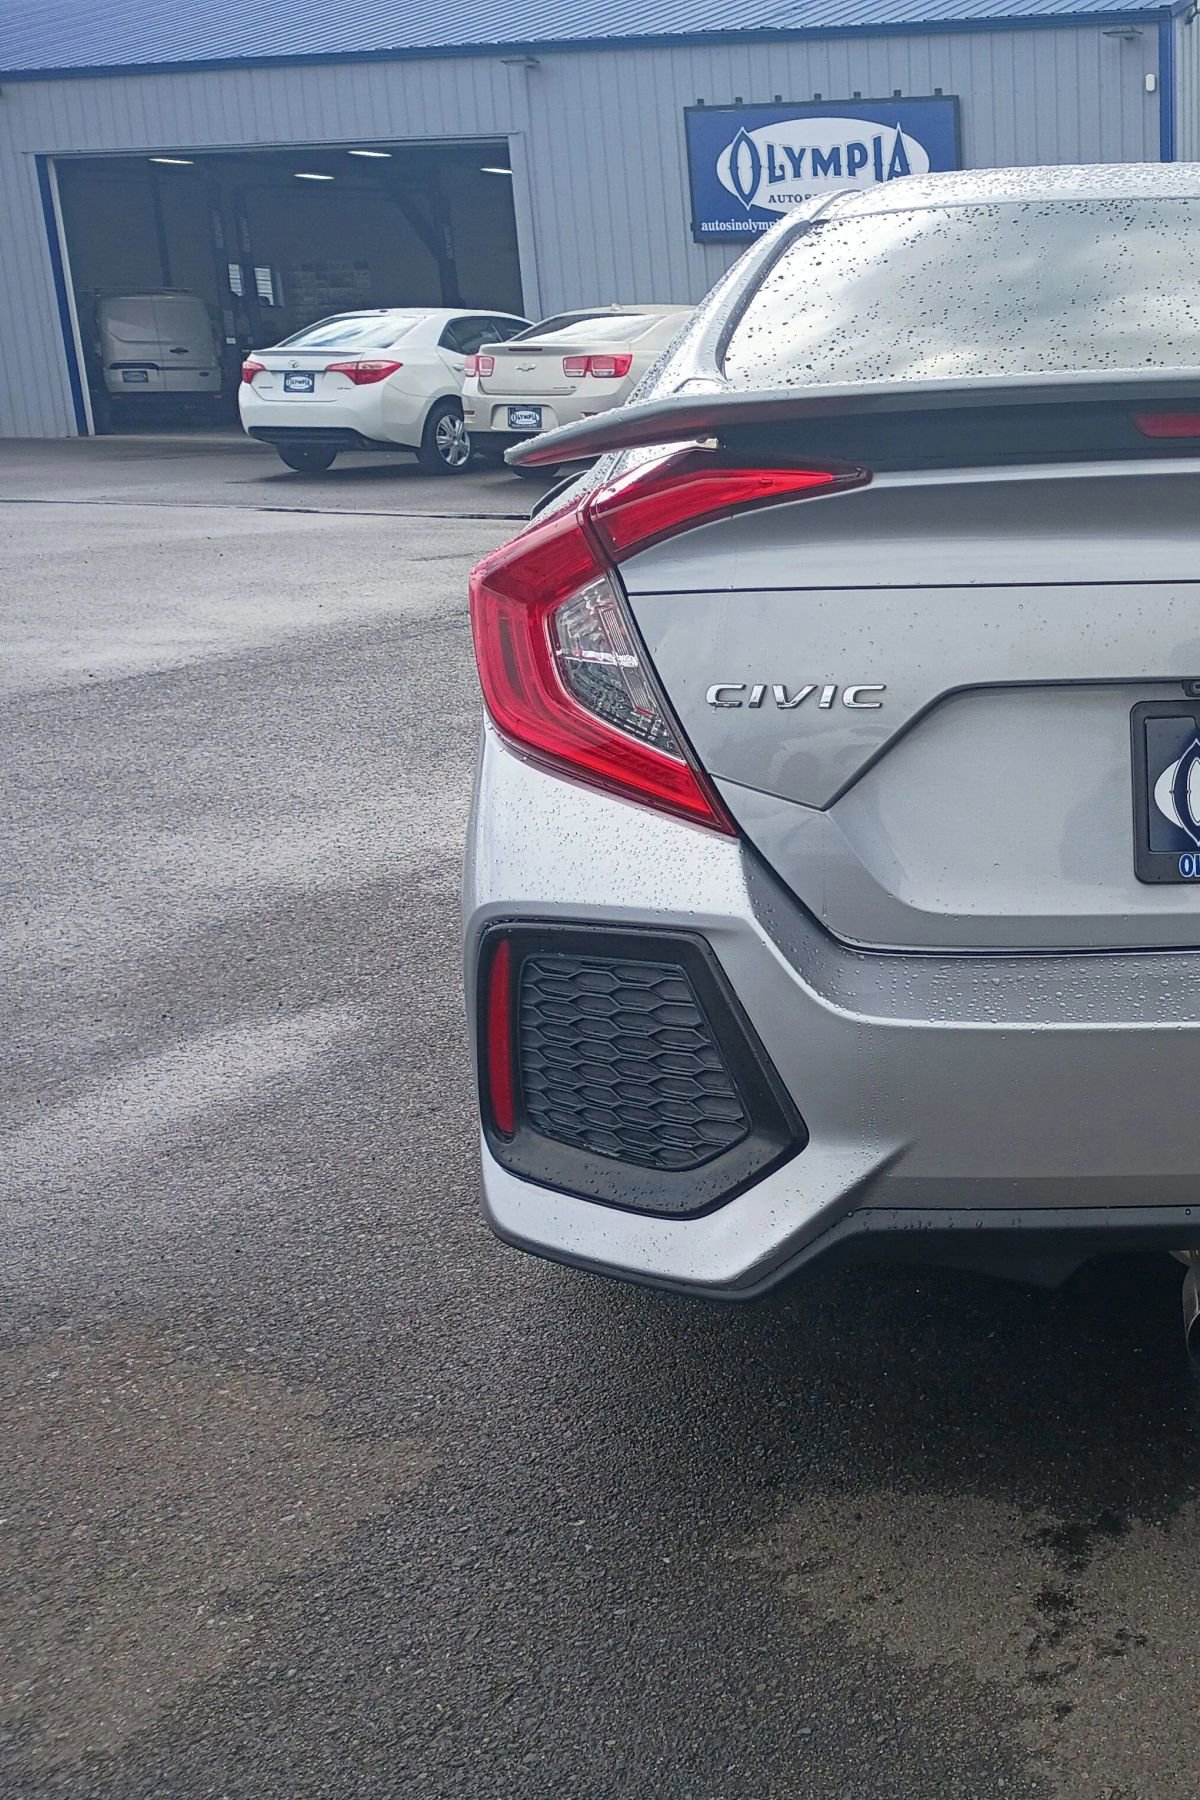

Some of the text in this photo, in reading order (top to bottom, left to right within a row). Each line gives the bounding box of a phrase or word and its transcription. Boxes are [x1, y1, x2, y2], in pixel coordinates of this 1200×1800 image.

[728, 122, 912, 211] OLYMPIA
[768, 194, 803, 204] AUTO
[701, 218, 780, 233] autosinolymp
[705, 683, 887, 709] CIVIC
